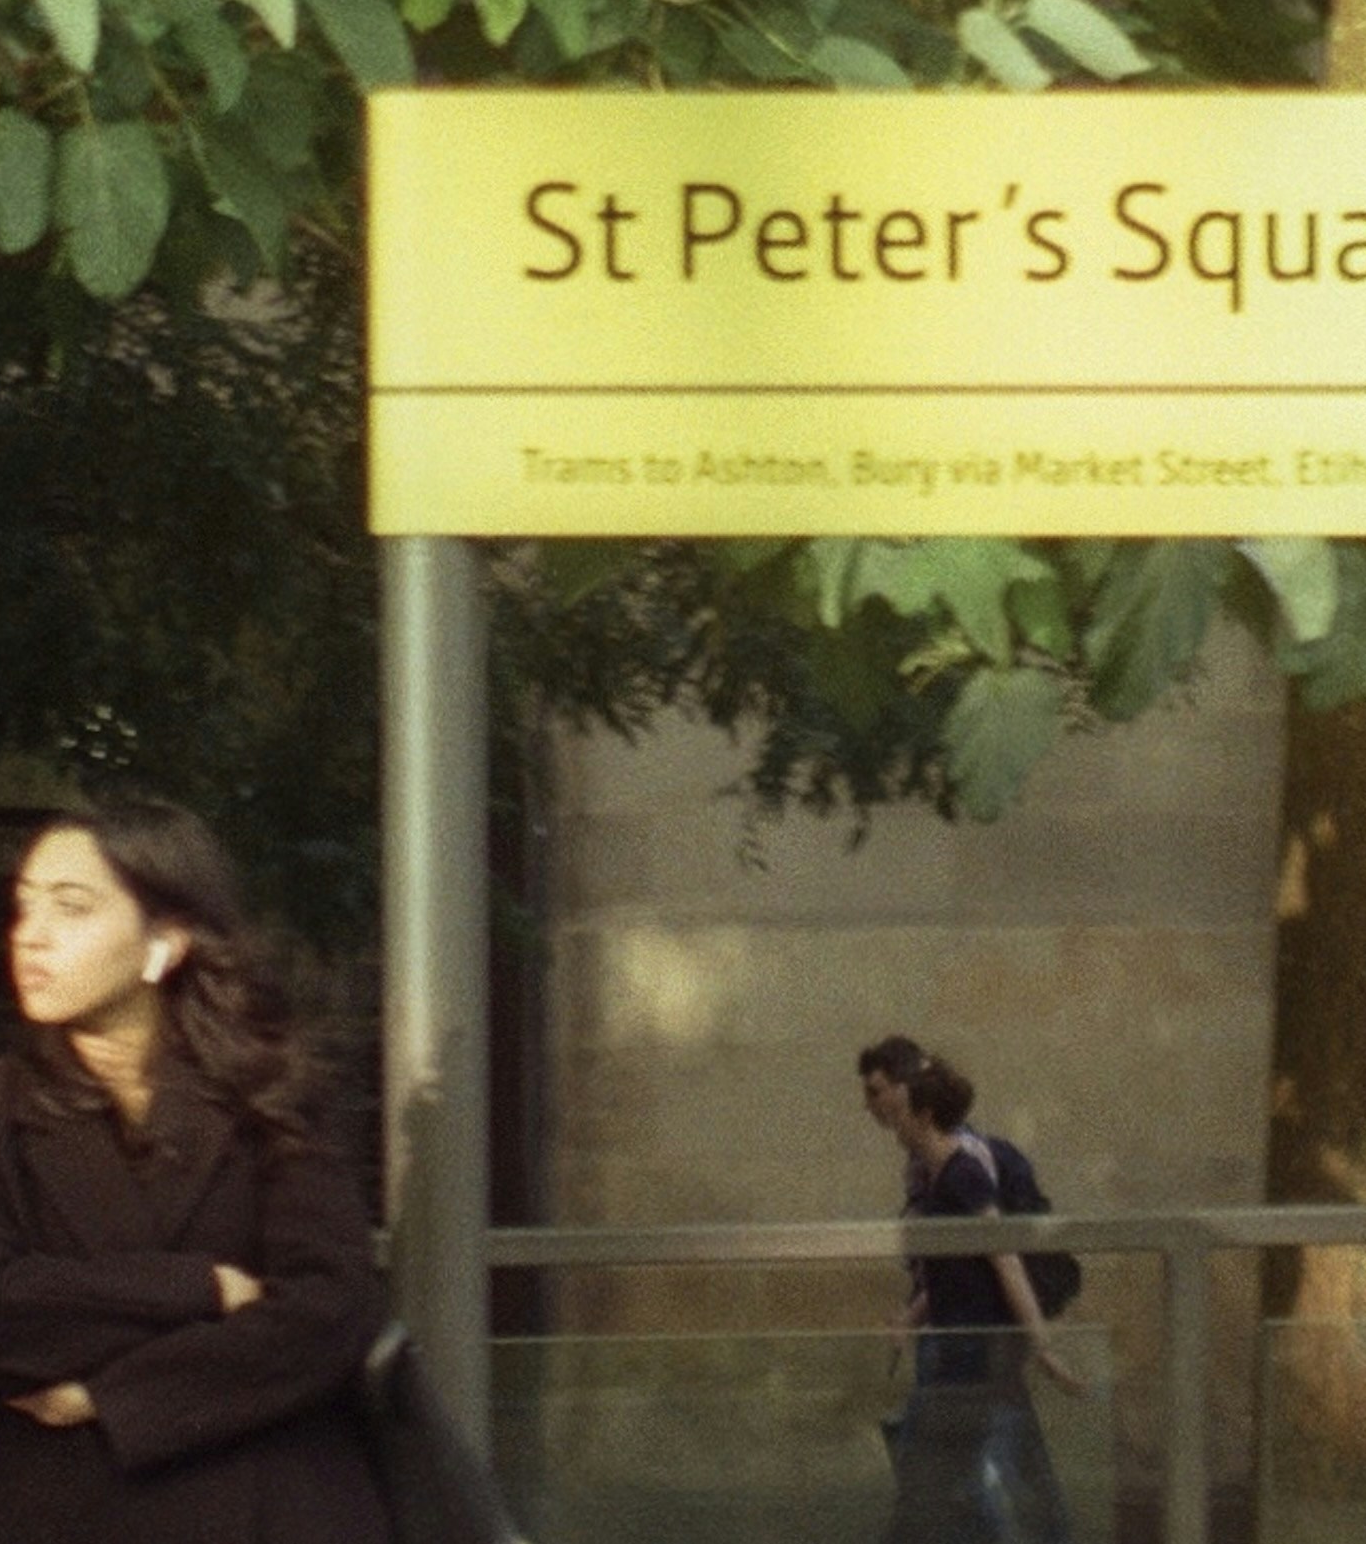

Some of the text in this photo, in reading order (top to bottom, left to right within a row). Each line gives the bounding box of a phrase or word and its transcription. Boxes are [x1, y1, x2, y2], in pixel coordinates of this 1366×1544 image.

[523, 179, 636, 284] St
[678, 180, 1071, 284] Peter's
[521, 446, 634, 485] Trams
[642, 451, 683, 485] to
[849, 448, 938, 496] Bury
[947, 453, 1003, 486] via
[1012, 450, 1144, 486] Market
